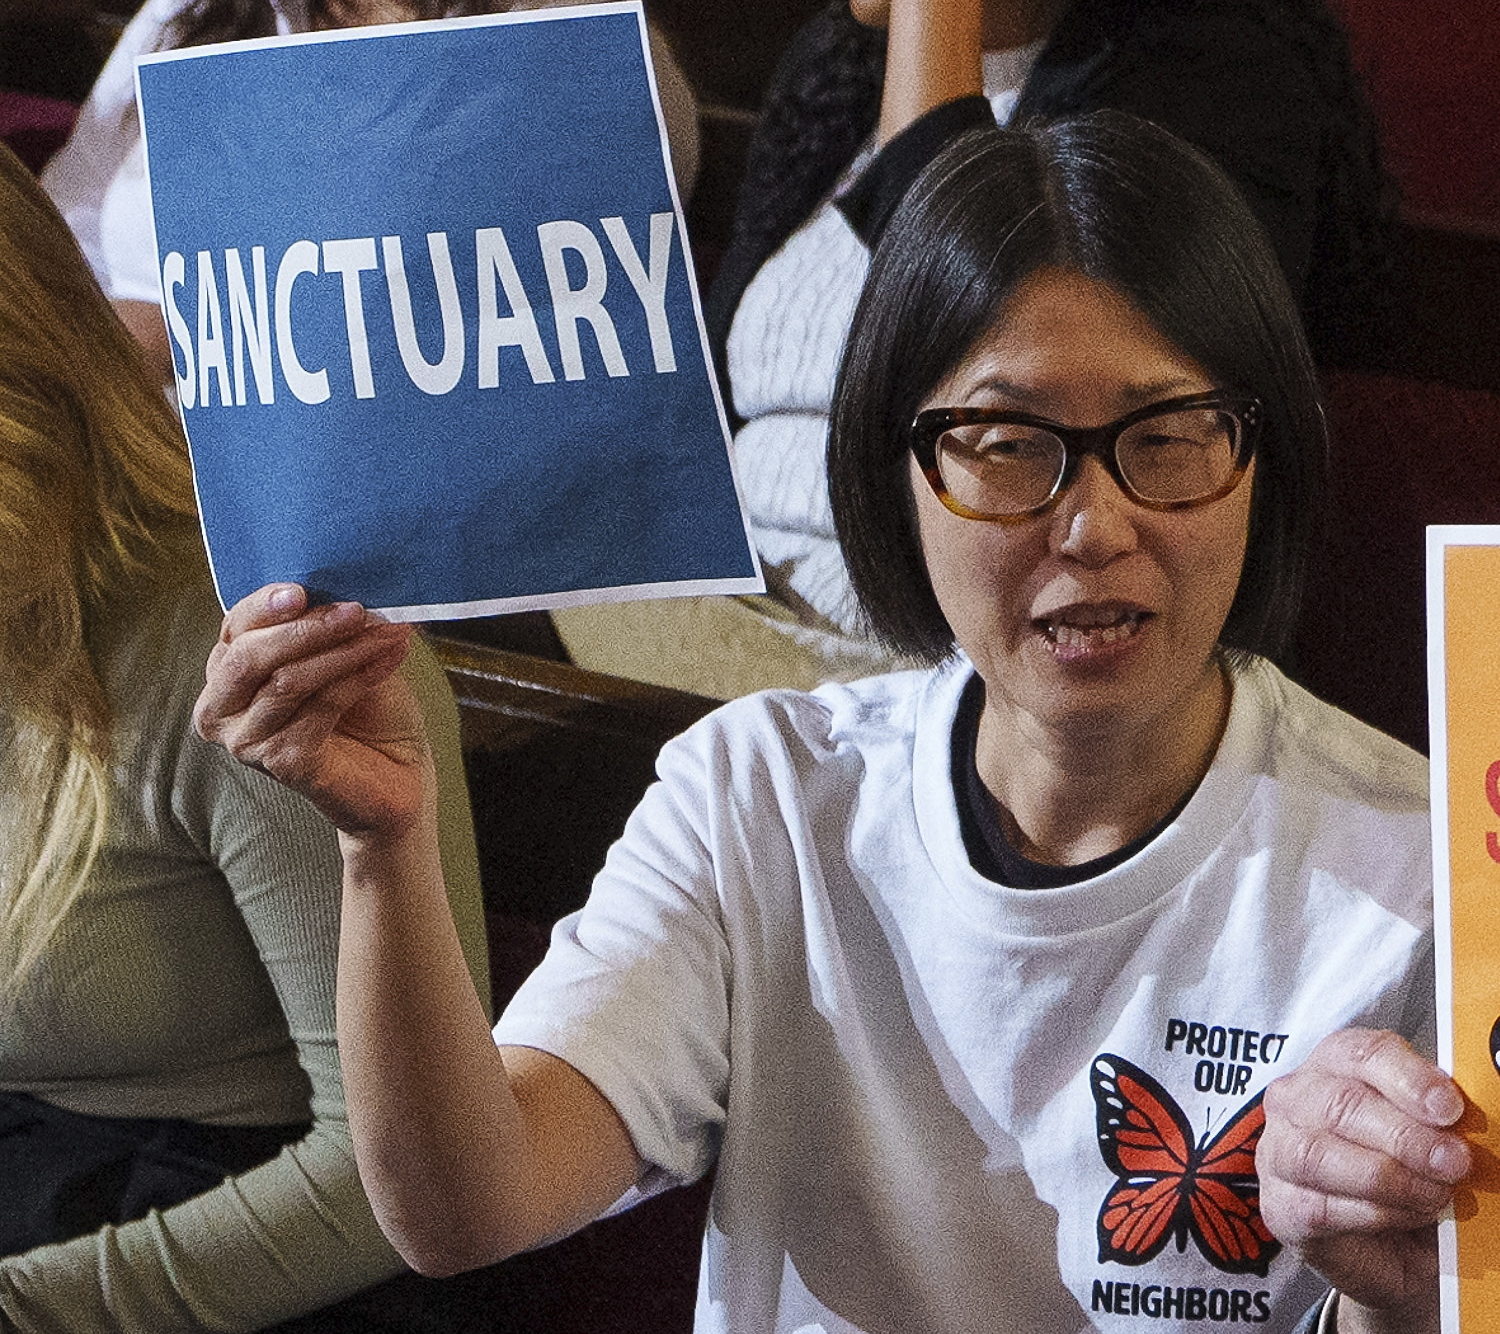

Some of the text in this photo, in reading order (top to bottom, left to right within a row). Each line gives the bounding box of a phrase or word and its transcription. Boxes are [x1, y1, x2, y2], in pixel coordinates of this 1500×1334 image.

[163, 211, 677, 409] SANCTUARY
[1164, 1018, 1289, 1064] PROTECT
[1194, 1059, 1252, 1096] OUR
[1091, 1278, 1271, 1323] NEIGHBORS
